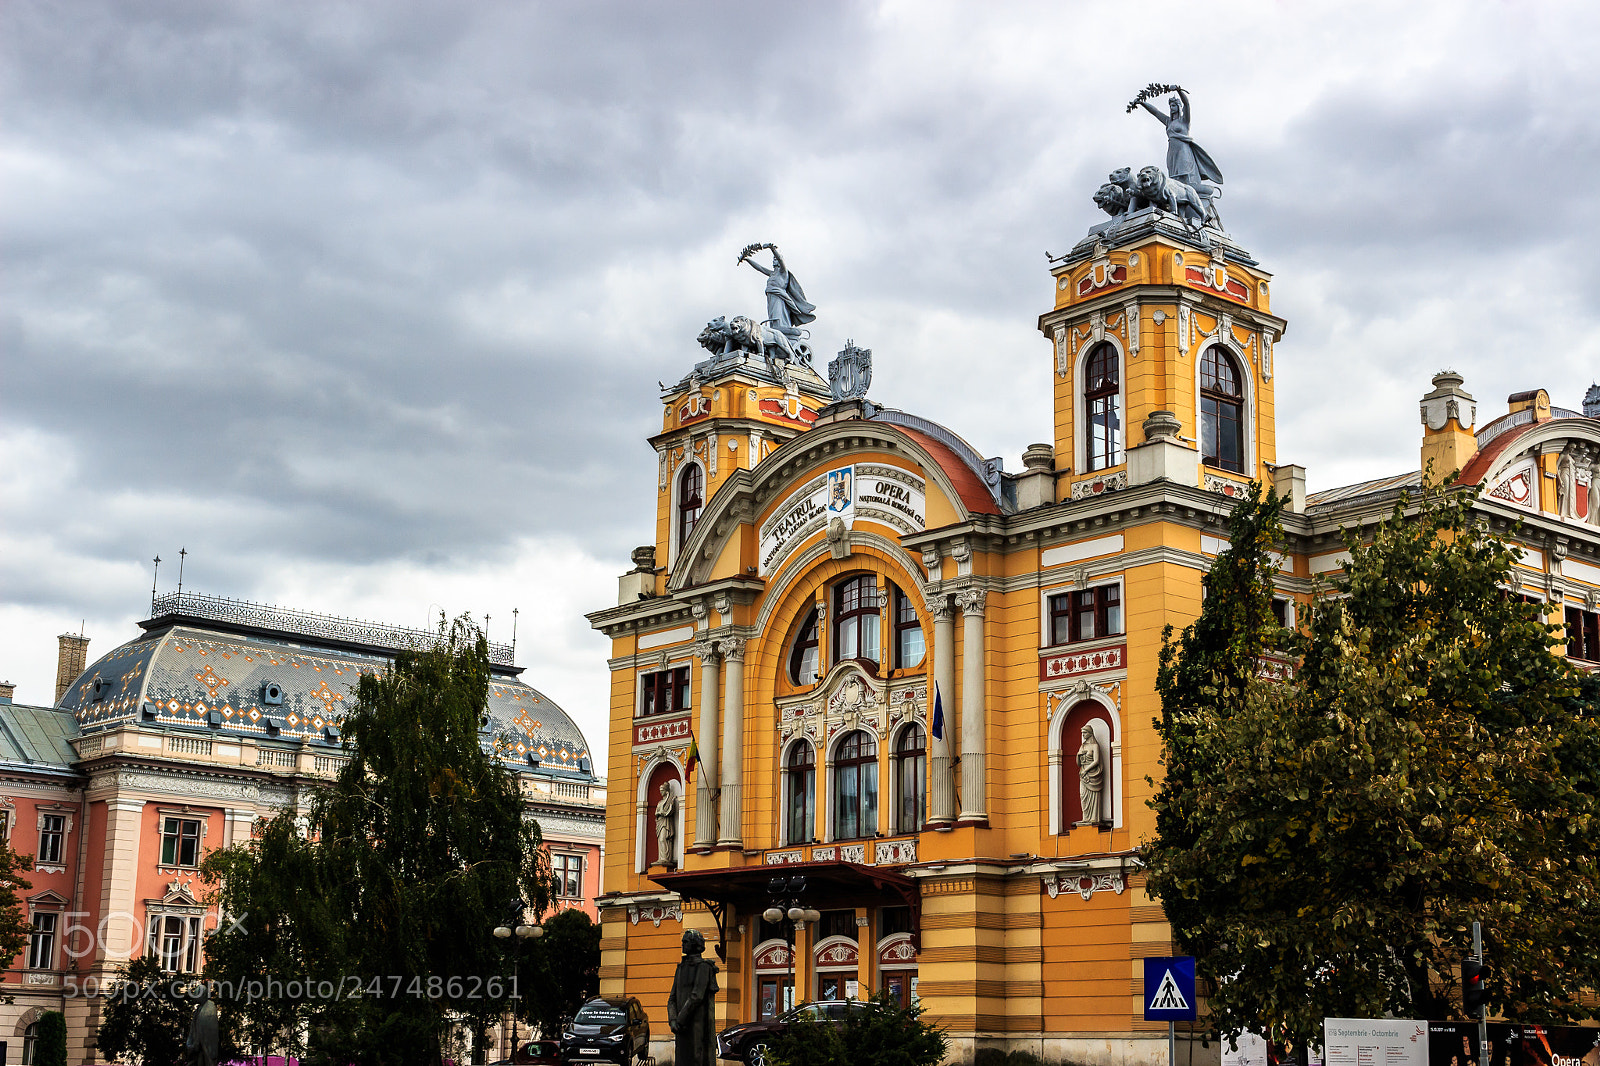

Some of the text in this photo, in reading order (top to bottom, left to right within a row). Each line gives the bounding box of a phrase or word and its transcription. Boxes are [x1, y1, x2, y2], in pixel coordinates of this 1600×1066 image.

[875, 481, 910, 504] OPERA
[772, 498, 816, 541] TEATRUL
[1337, 1028, 1367, 1038] Septembrie
[1371, 1029, 1399, 1037] Octombrie
[1551, 1053, 1581, 1066] Opera
